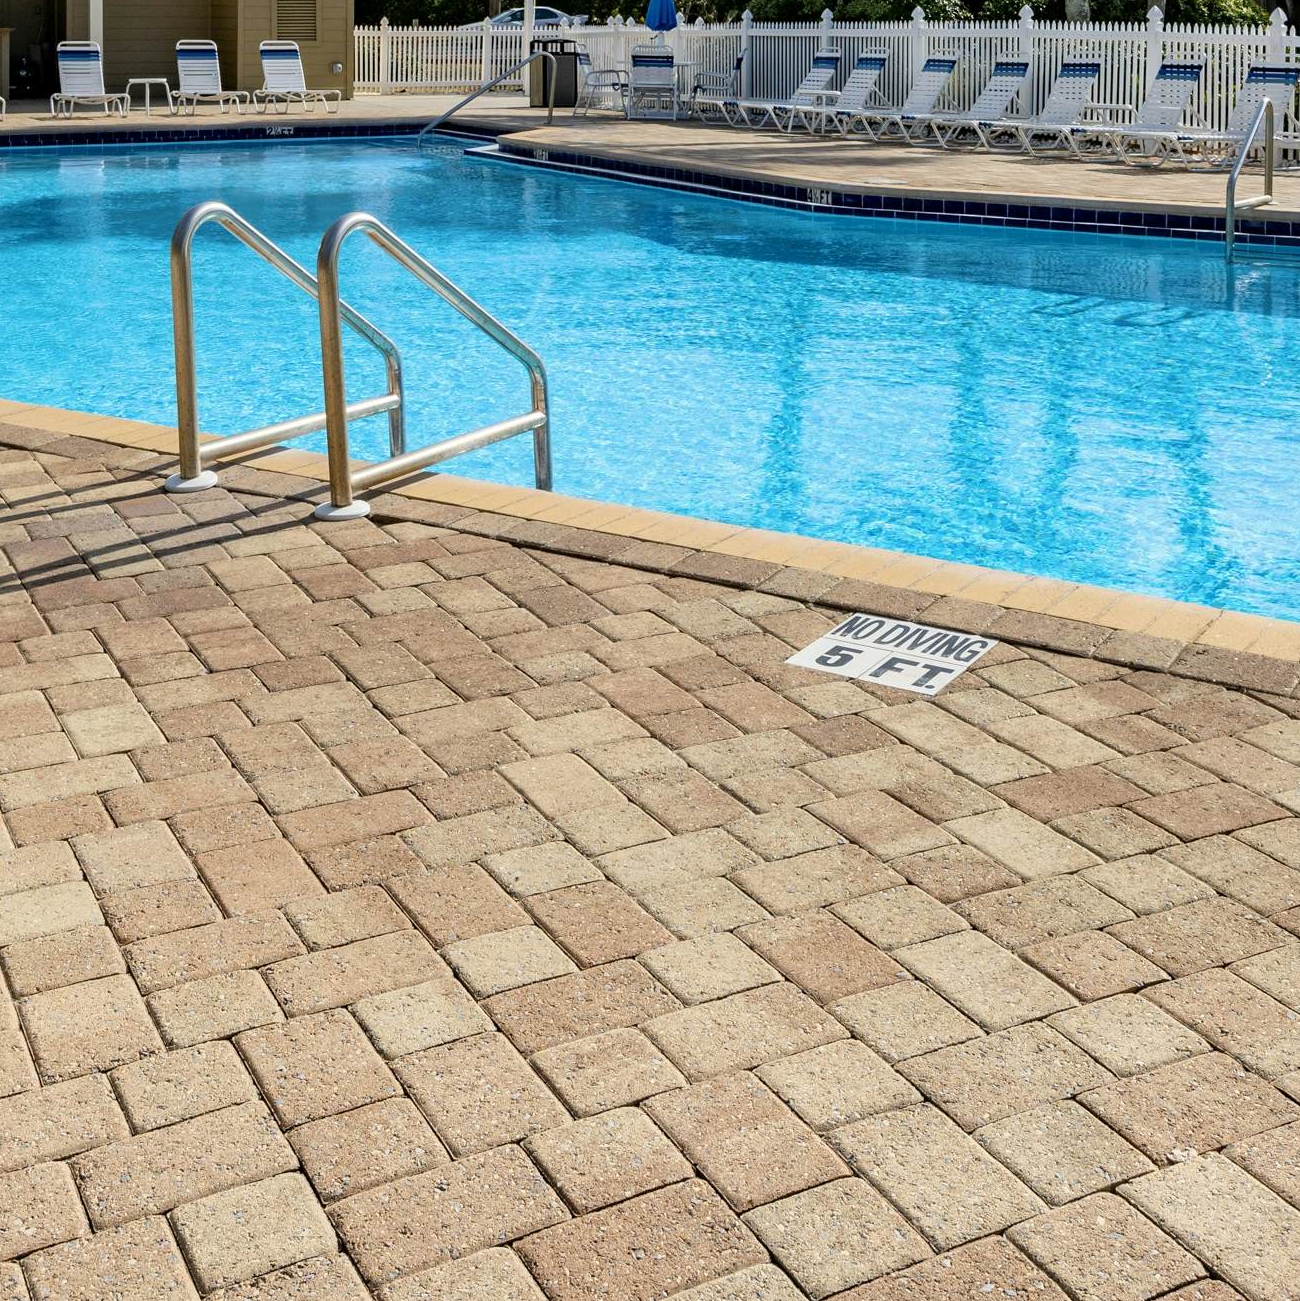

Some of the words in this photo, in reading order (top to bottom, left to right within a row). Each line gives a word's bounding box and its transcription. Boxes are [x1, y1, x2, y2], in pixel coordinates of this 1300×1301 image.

[831, 615, 885, 640] NO
[873, 624, 989, 663] DIVING
[815, 645, 863, 668] 5
[868, 656, 955, 690] FT.
